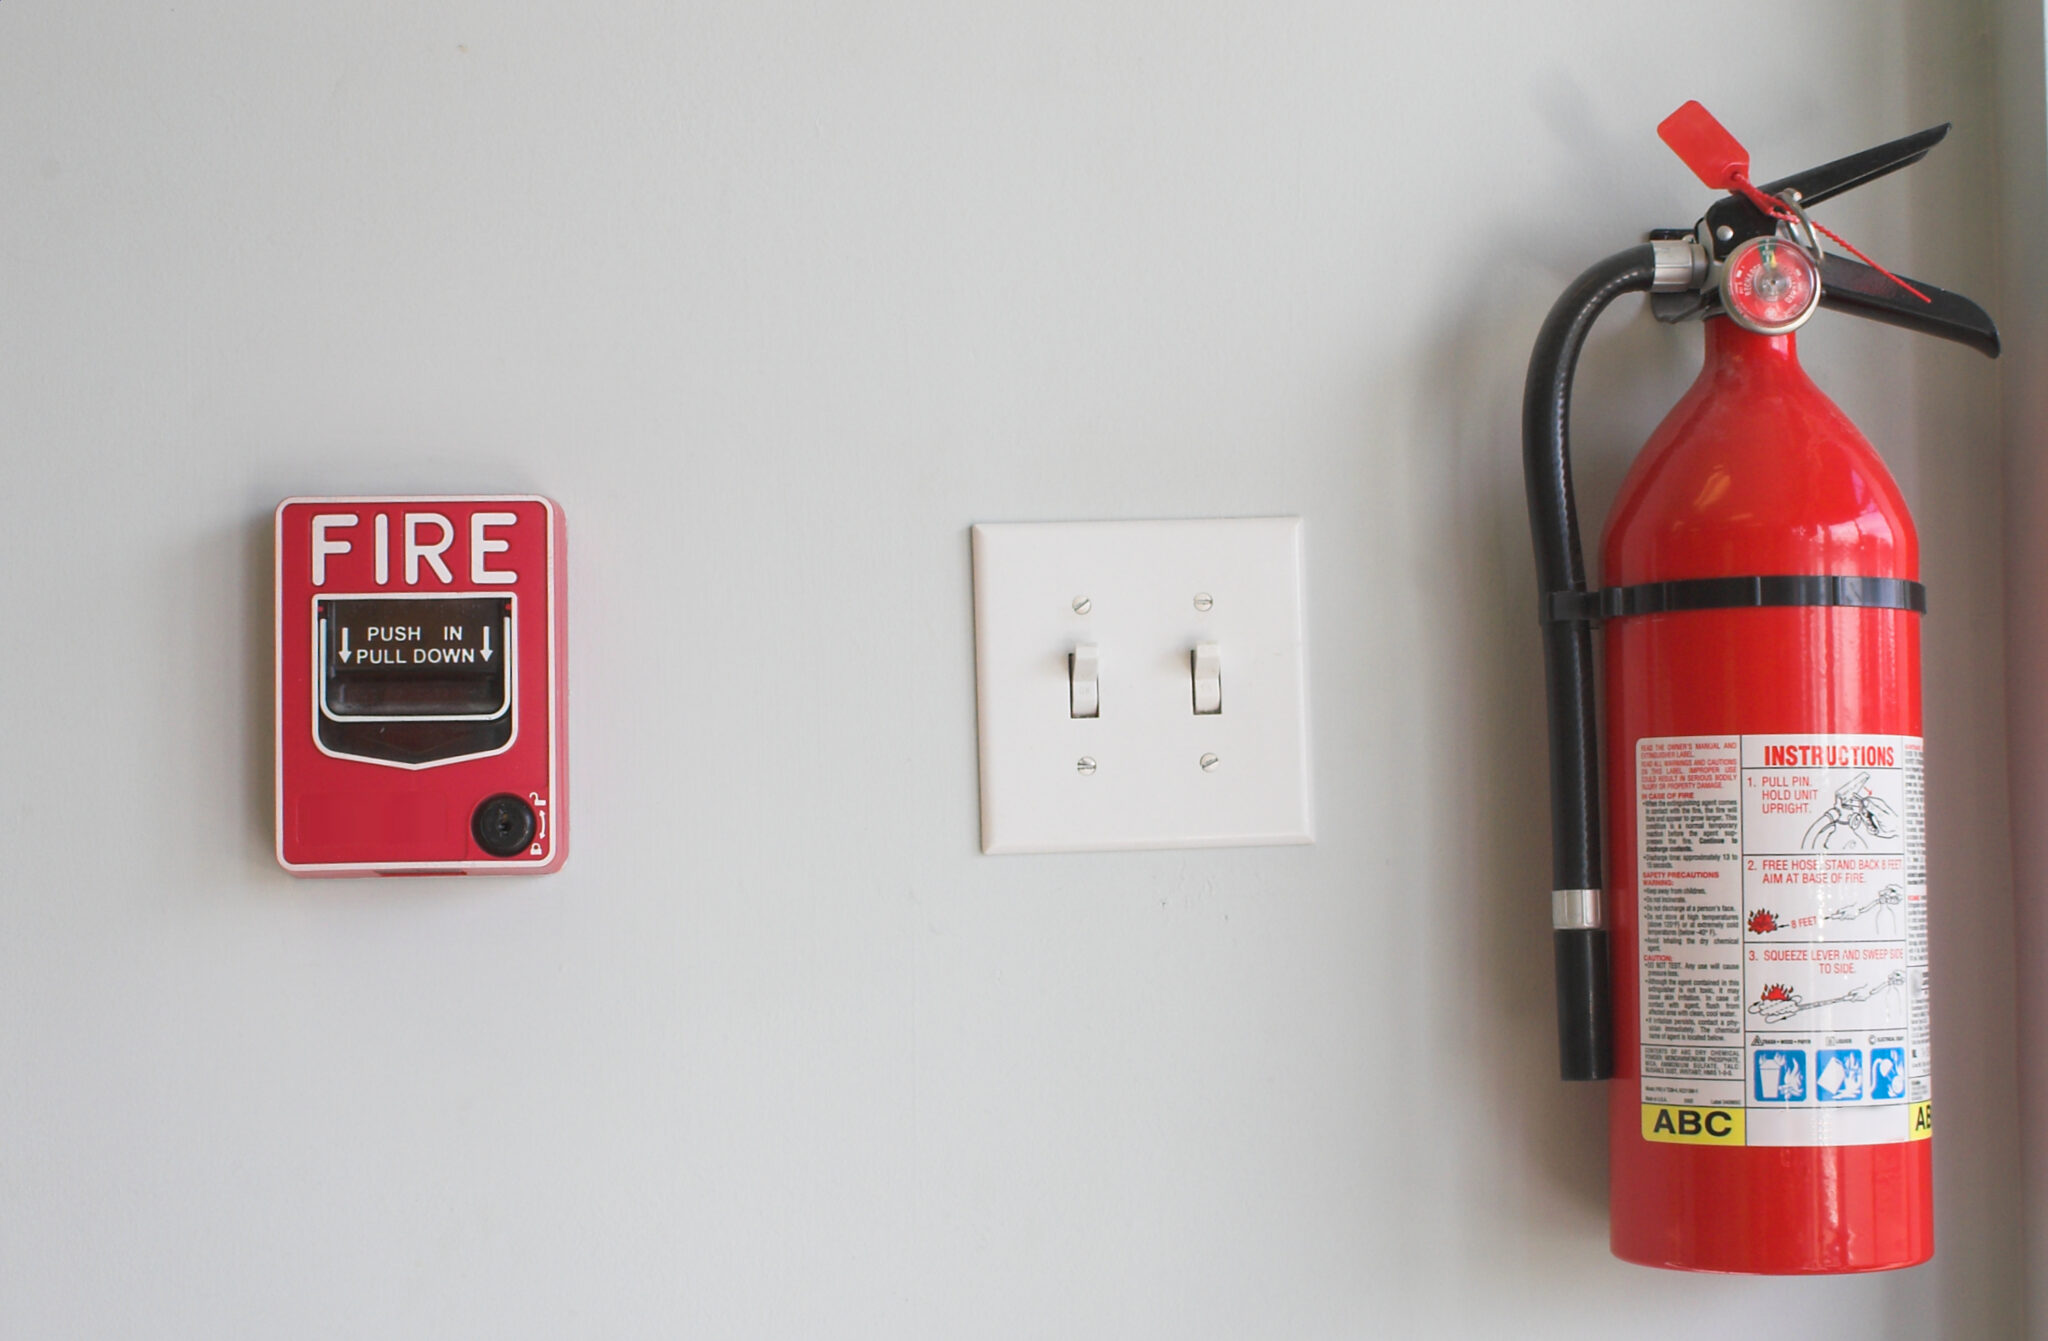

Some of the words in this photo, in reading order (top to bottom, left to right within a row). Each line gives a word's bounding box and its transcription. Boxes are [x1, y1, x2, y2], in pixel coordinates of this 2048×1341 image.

[312, 513, 517, 587] FIRE
[368, 627, 420, 641] PUSH
[444, 626, 462, 640] IN
[357, 649, 406, 664] PULL
[413, 648, 474, 663] DOWN
[1764, 745, 1894, 767] INSTRUCTIONS
[1747, 778, 1756, 787] 1.
[1761, 777, 1789, 787] PULL
[1792, 776, 1812, 787] PIN.
[1762, 790, 1791, 800] HOLD
[1794, 790, 1818, 800] UNIT
[1762, 803, 1812, 814] UPRIGHT.
[1747, 861, 1757, 871] 2.
[1762, 860, 1788, 871] FREE
[1826, 860, 1856, 870] STAND
[1858, 860, 1880, 870] BACK
[1762, 873, 1783, 884] AIM
[1786, 873, 1799, 884] AT
[1802, 873, 1828, 884] BASE
[1830, 873, 1842, 883] OF
[1845, 873, 1867, 883] FIRE.
[1791, 918, 1797, 928] 8
[1798, 915, 1817, 927] FEET
[1748, 951, 1758, 961] 3.
[1763, 950, 1807, 961] SQUEEZE
[1811, 949, 1839, 960] LEVER
[1842, 949, 1860, 960] AND
[1863, 949, 1888, 960] SWEEP
[1890, 948, 1903, 960] SIDE
[1819, 963, 1832, 974] TO
[1834, 963, 1856, 974] SIDE.
[1653, 1109, 1732, 1137] ABC
